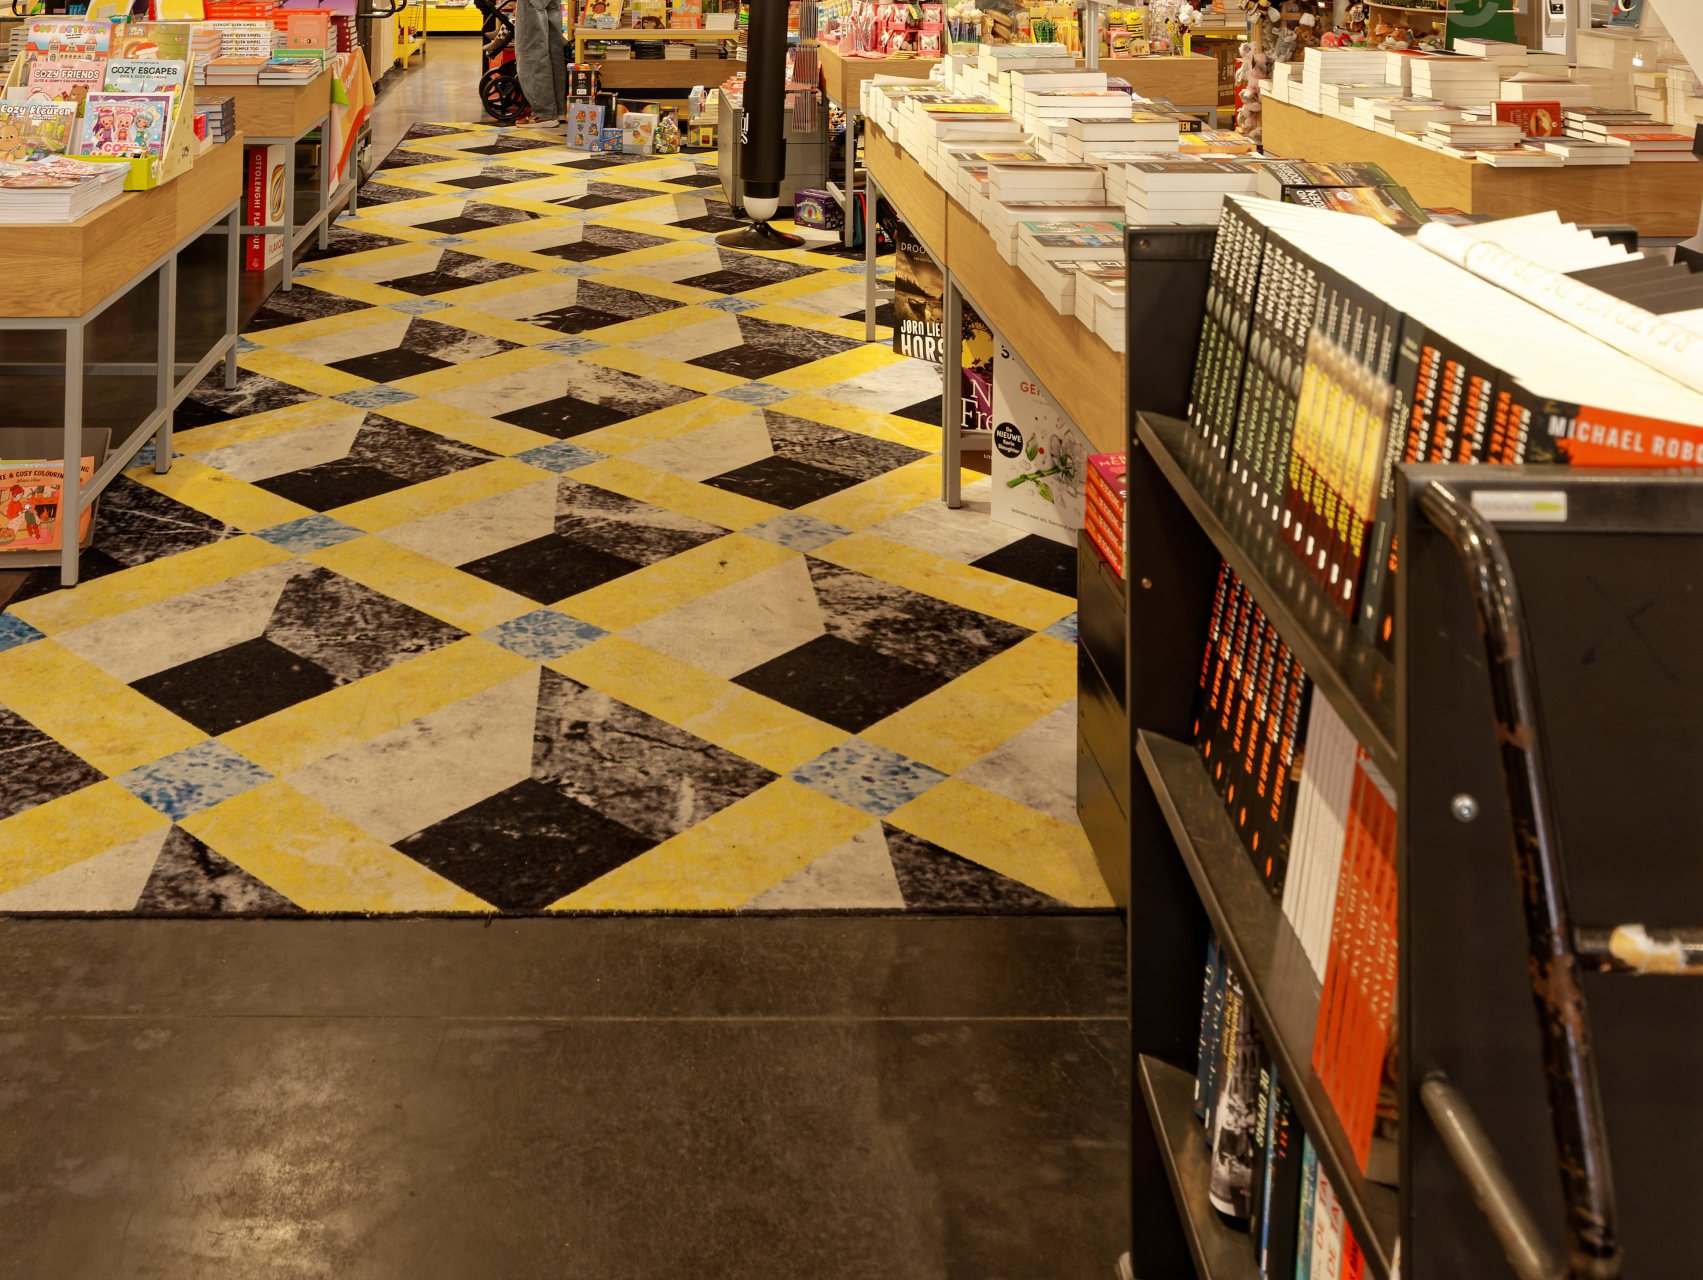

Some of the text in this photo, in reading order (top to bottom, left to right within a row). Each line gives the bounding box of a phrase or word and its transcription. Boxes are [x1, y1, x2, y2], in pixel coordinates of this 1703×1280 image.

[34, 70, 100, 79] COZY FRIENDS
[111, 66, 178, 75] COZY ESCAPES
[0, 104, 71, 116] Cozy kleuren
[252, 154, 262, 250] OTTOLENGHI FLAOUR
[901, 242, 926, 253] DROO
[900, 319, 944, 337] JØRN LIE
[996, 430, 1021, 443] NIEUWE
[1548, 415, 1644, 453] MICHAEL
[33, 470, 65, 479] COLOURIN
[1255, 1067, 1270, 1149] DE OPPAS
